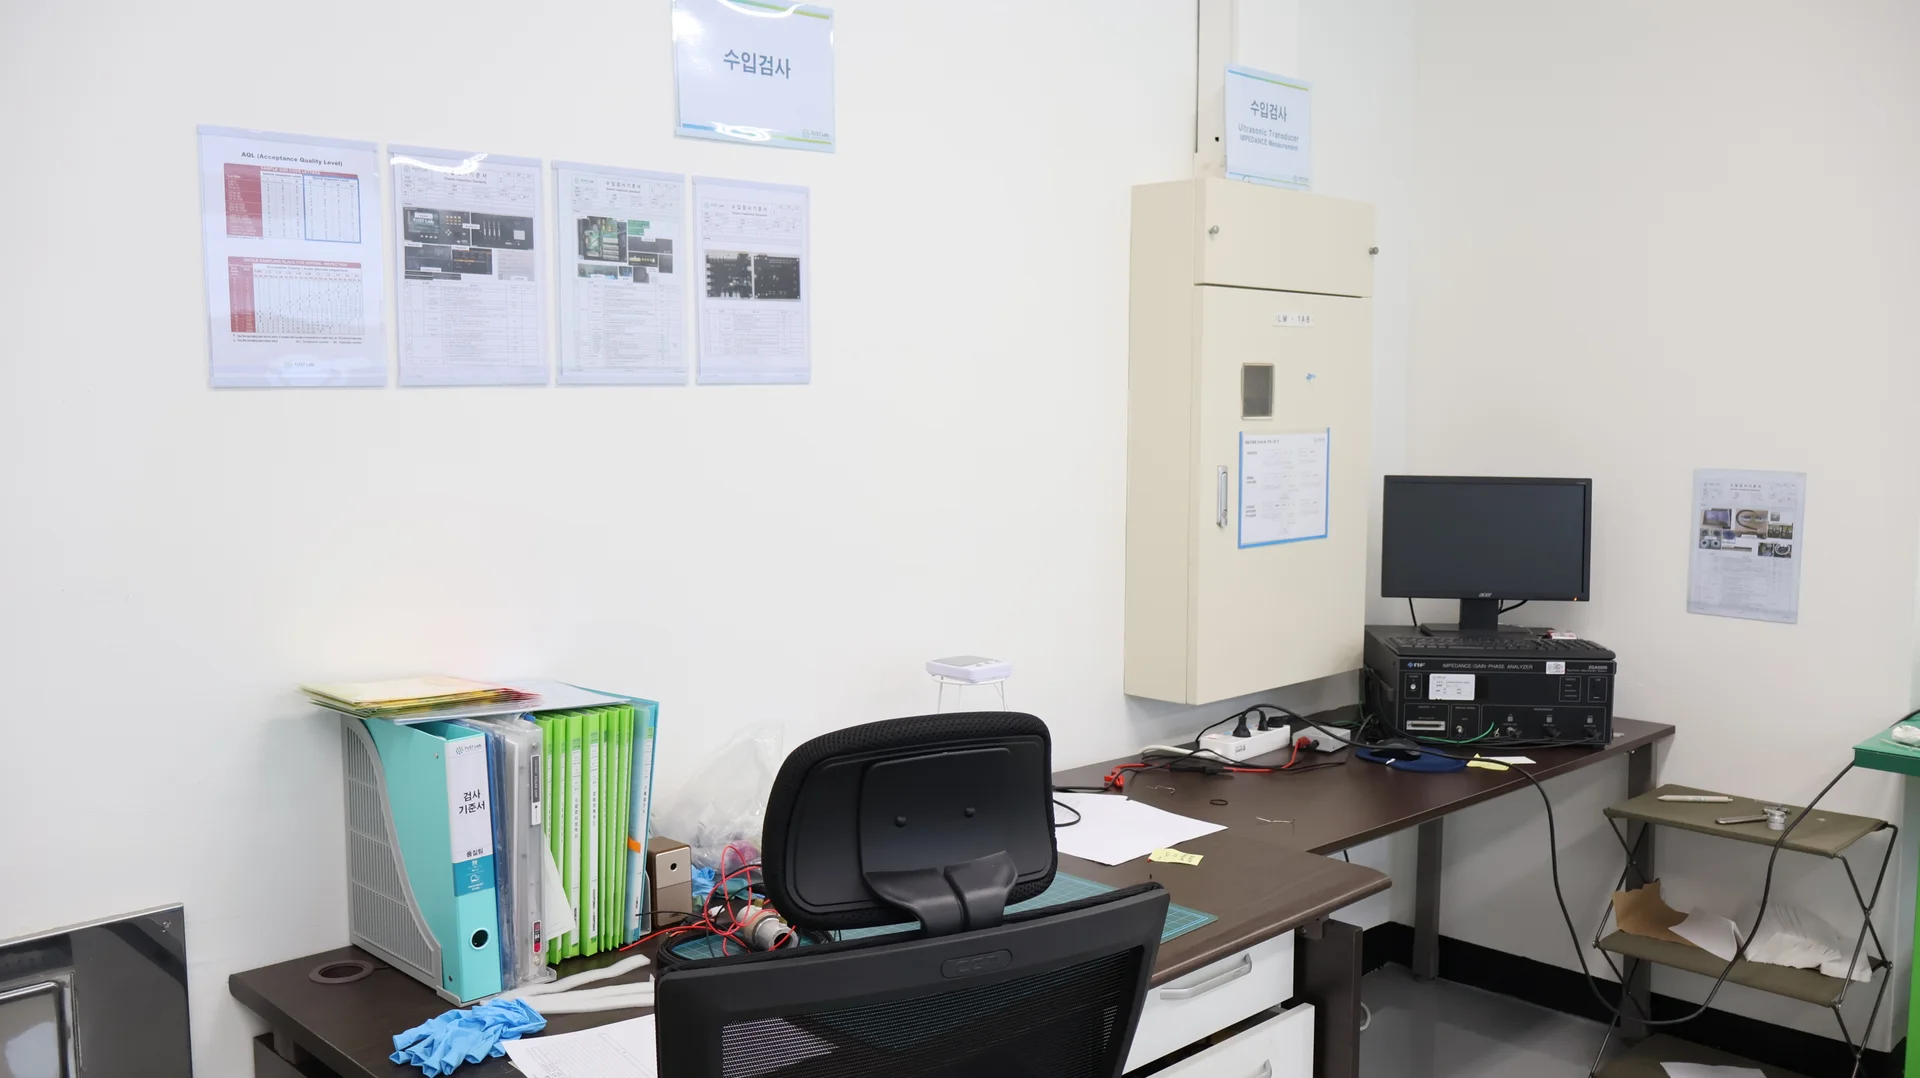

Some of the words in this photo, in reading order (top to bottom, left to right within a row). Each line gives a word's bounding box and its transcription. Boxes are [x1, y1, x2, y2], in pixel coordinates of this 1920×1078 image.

[723, 49, 791, 79] 수입검사
[1250, 100, 1288, 122] 수입검사
[1238, 123, 1268, 136] Ultrasonic
[1268, 129, 1300, 142] Transducer
[1240, 134, 1268, 146] IMPEDANCE
[1268, 139, 1299, 152] Measurement
[257, 152, 298, 162] (Acceptance
[299, 157, 322, 166] Quality
[324, 159, 343, 167] Level)
[464, 789, 481, 802] 검사
[458, 800, 486, 814] 기준서
